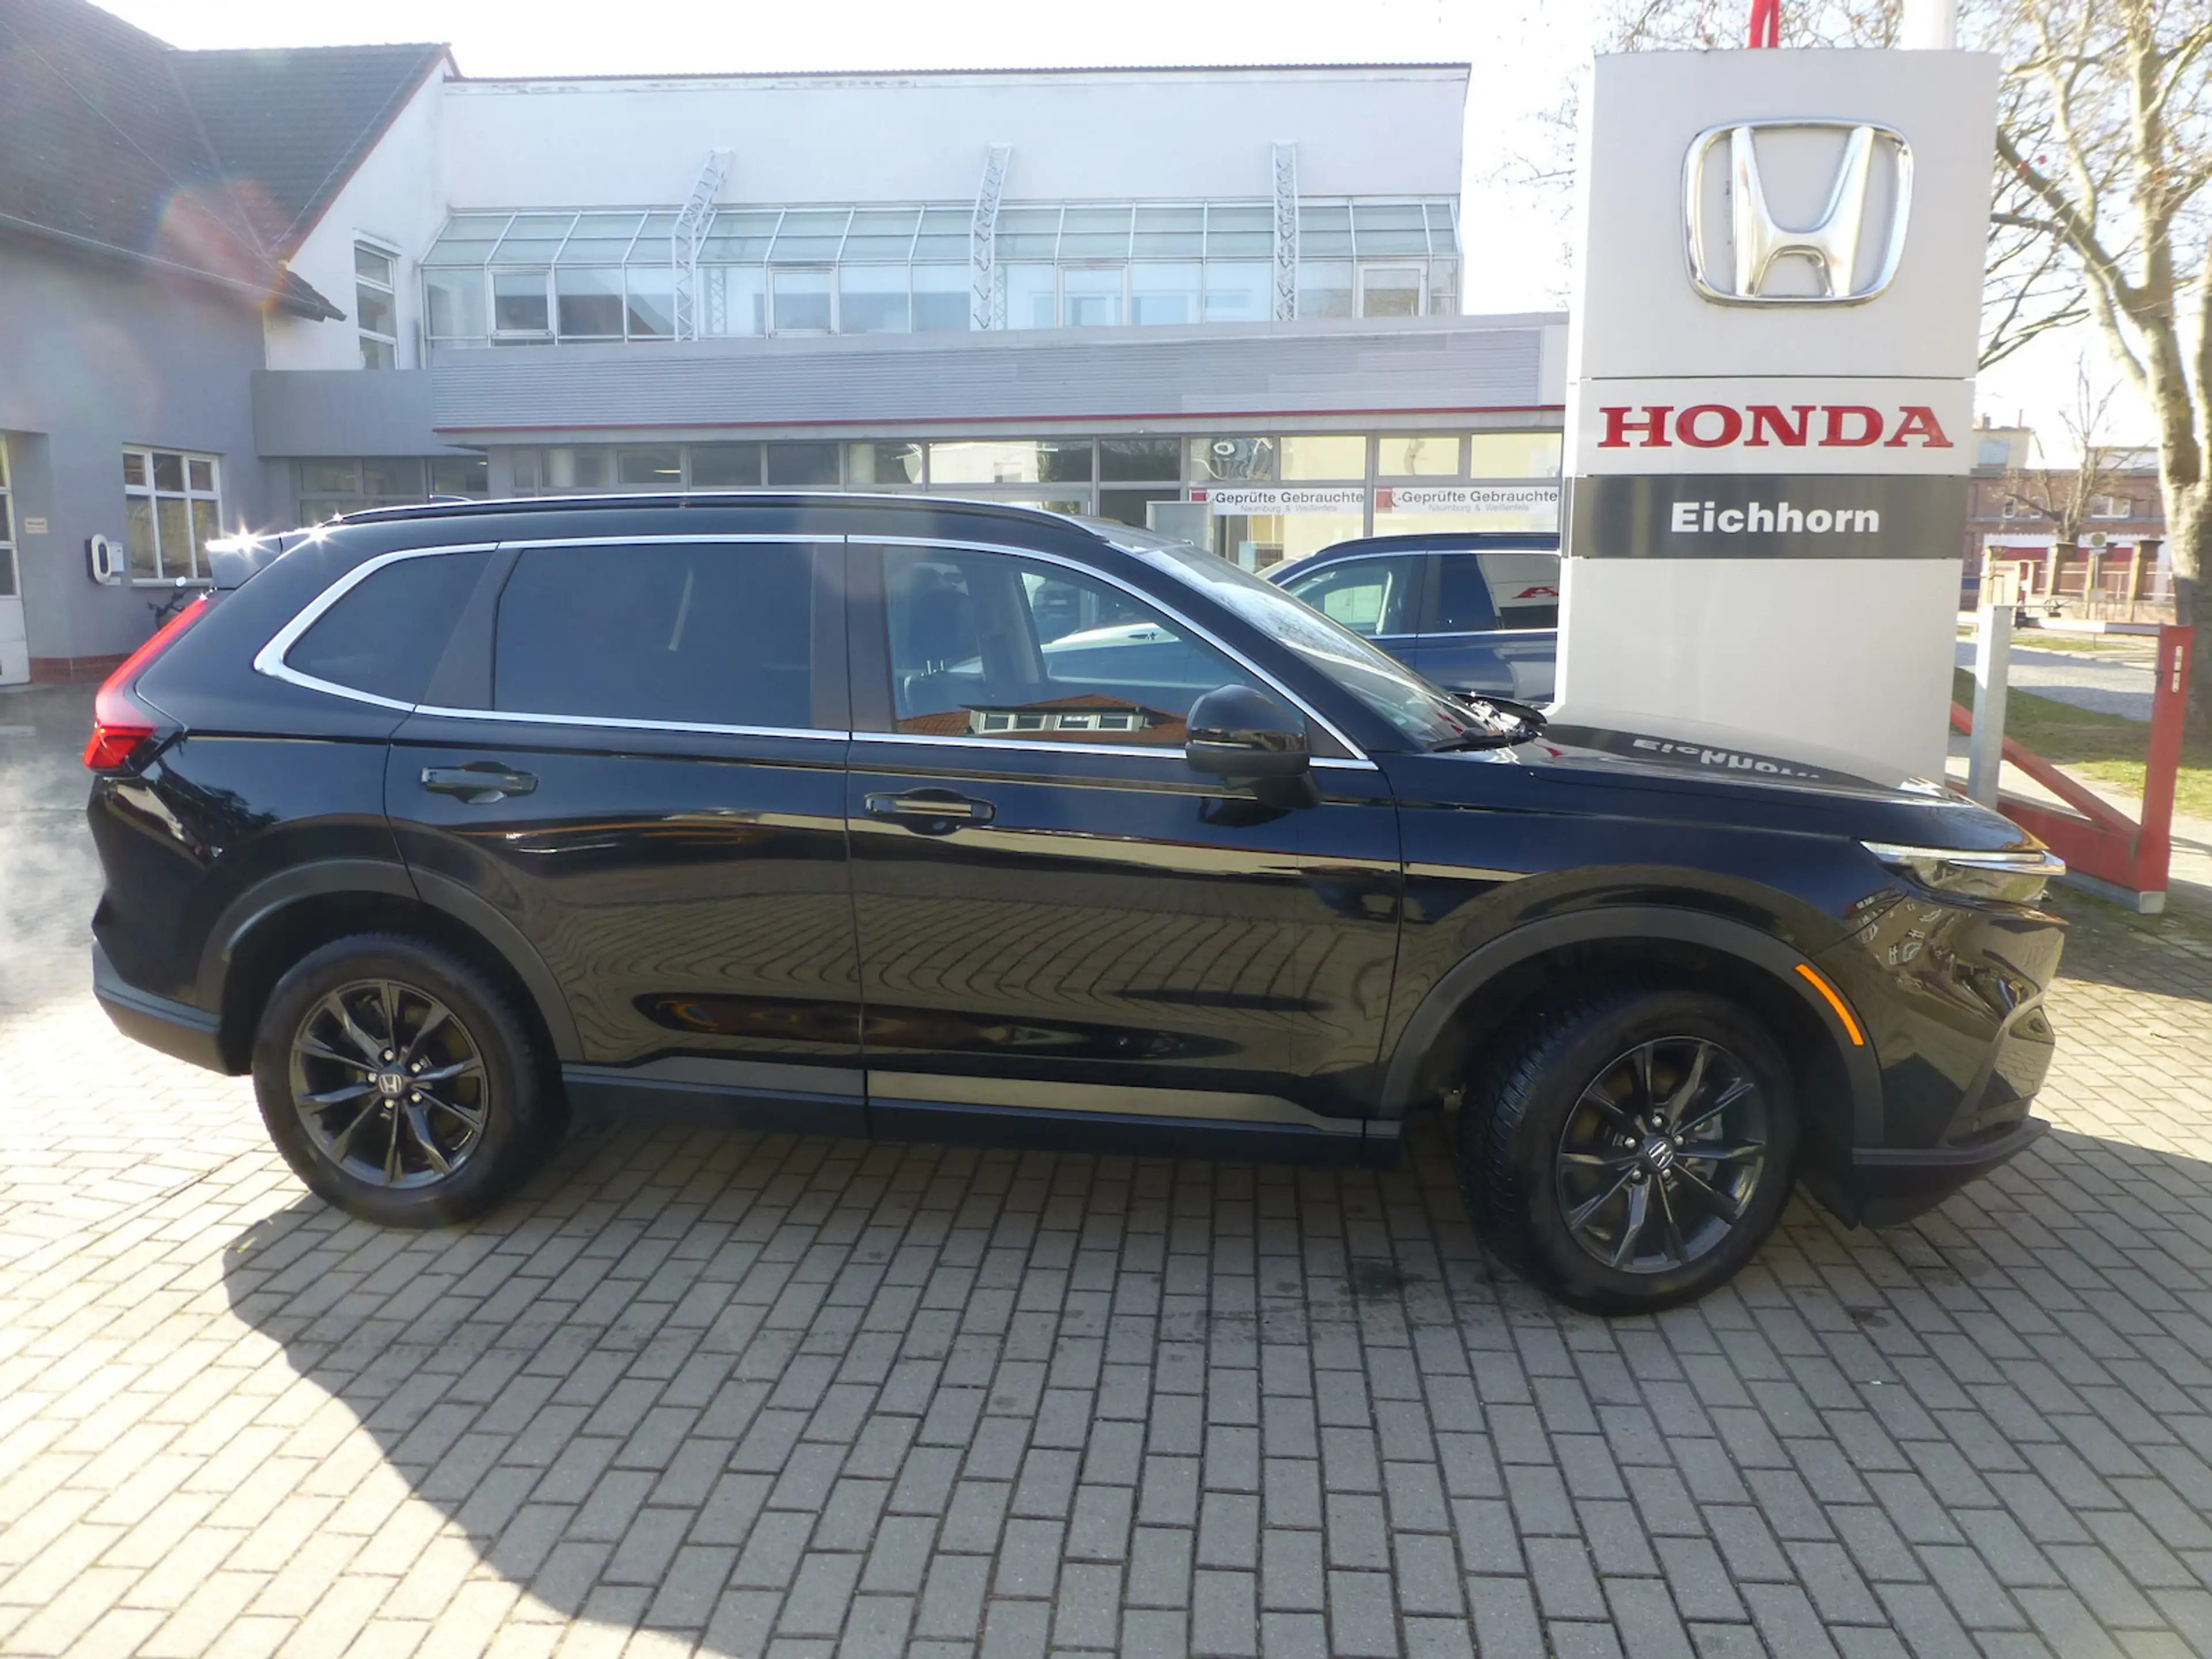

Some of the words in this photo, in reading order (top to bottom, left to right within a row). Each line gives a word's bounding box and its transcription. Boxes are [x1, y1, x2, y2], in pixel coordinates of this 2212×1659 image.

[1597, 404, 1954, 448] HONDA
[1281, 491, 1363, 503] Gebrauchte
[1470, 491, 1558, 502] Gebrauchte
[1671, 502, 1880, 533] Eichhorn
